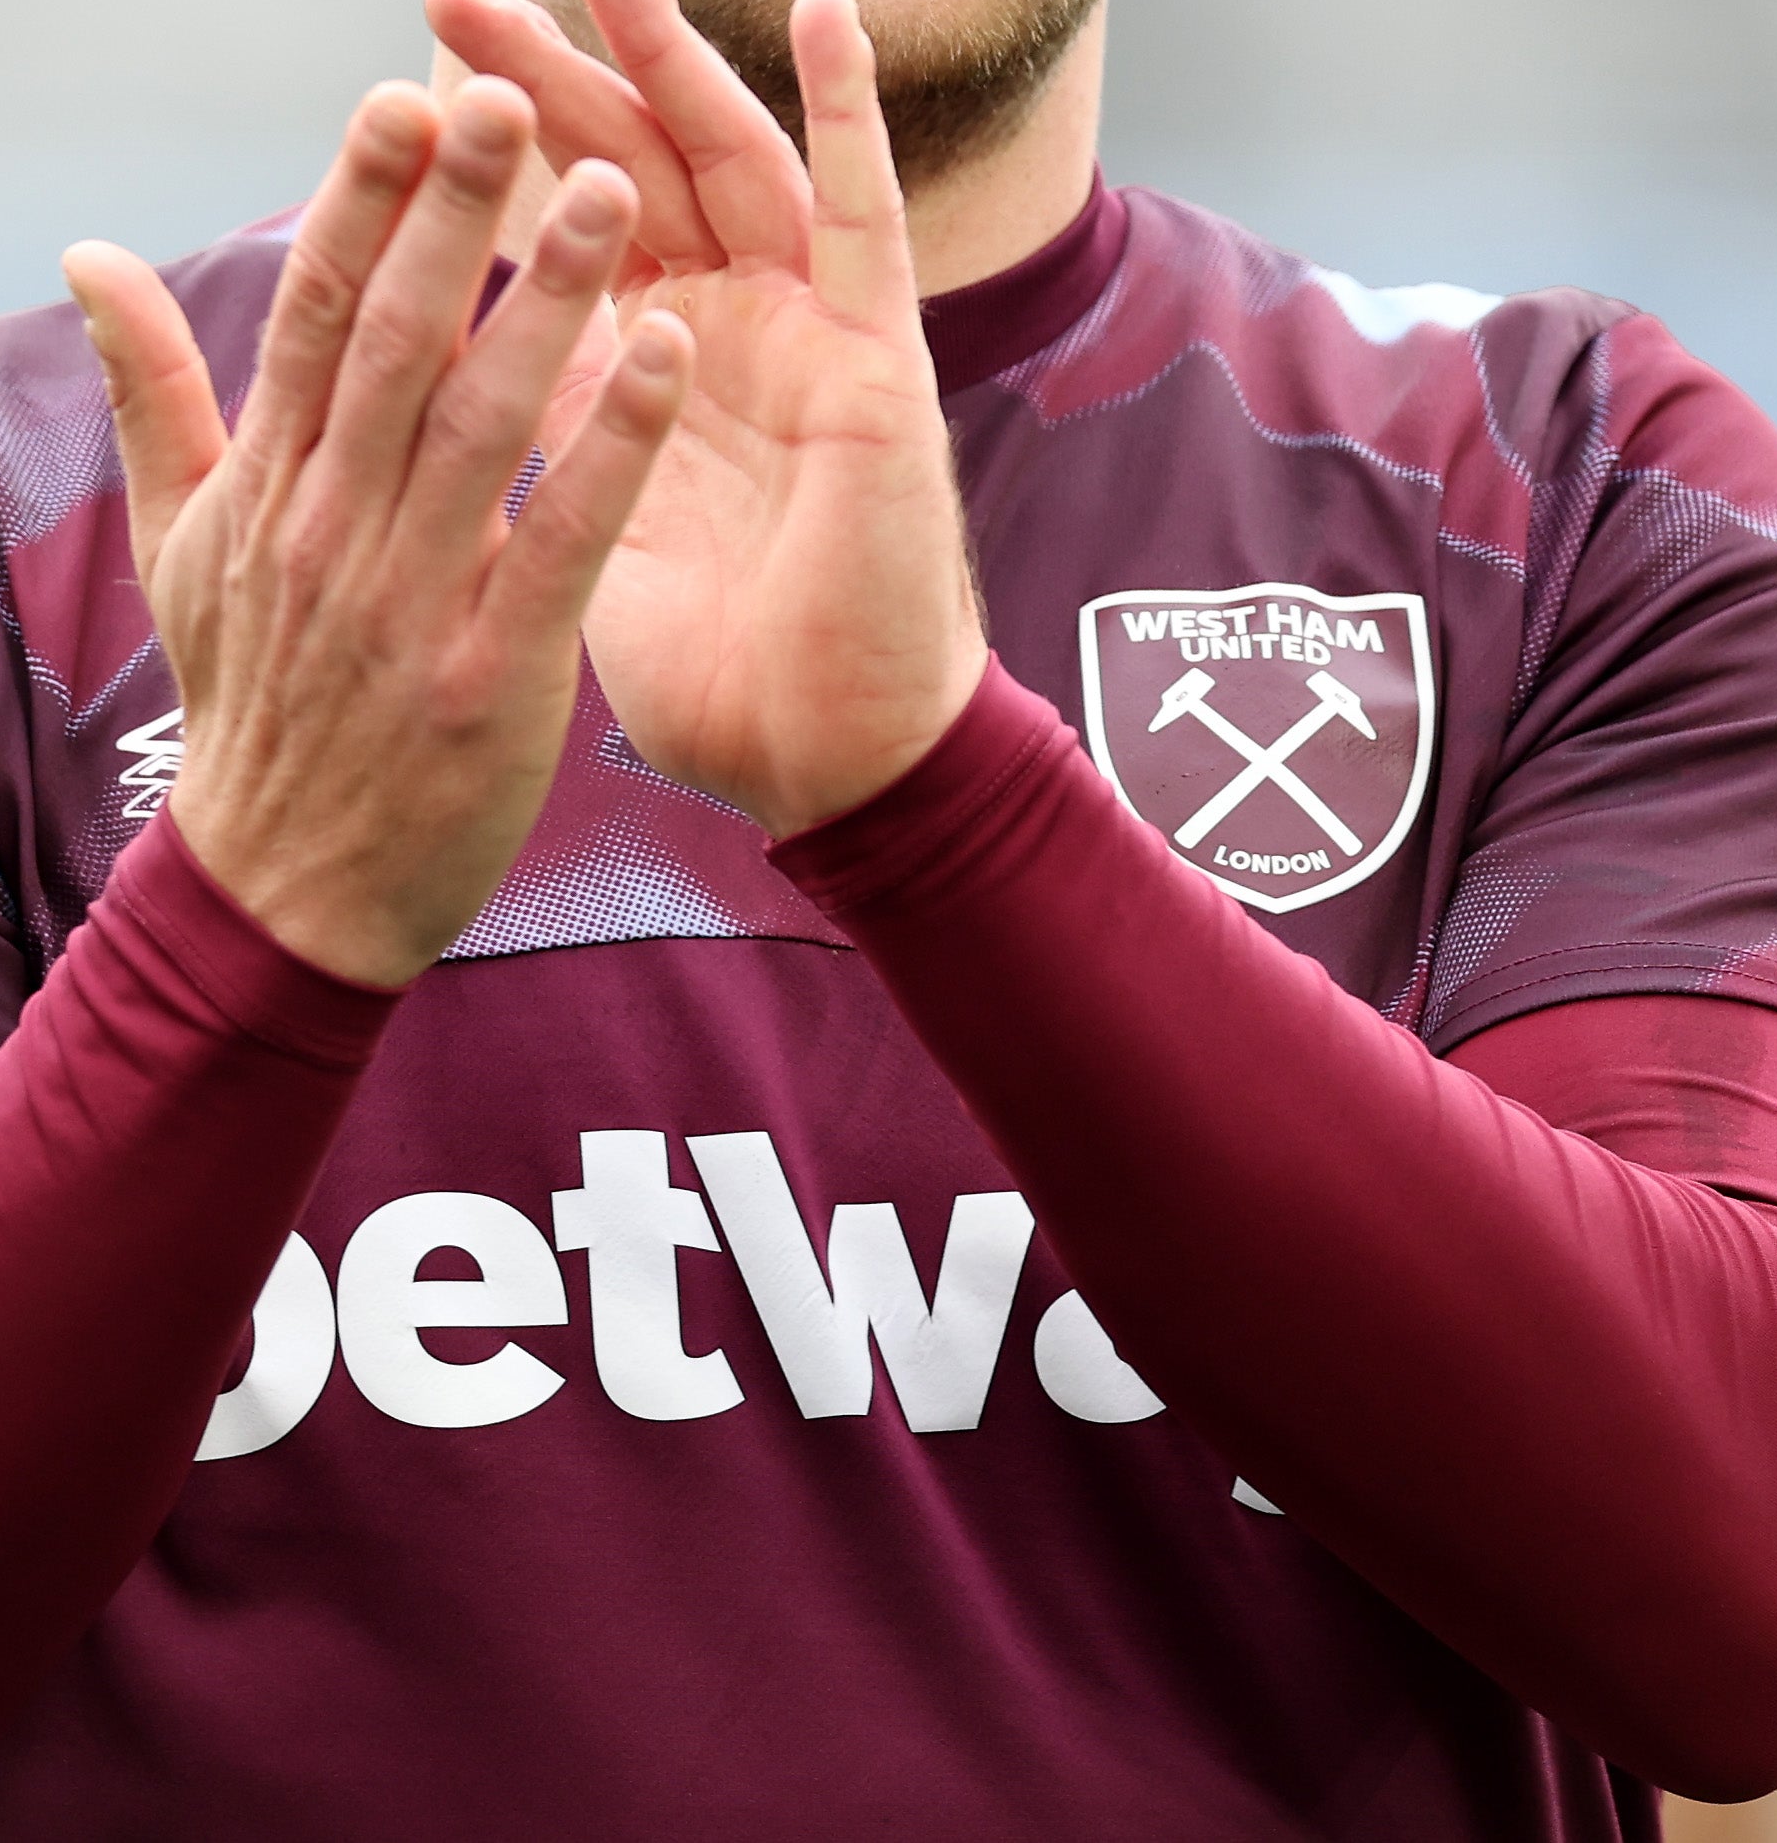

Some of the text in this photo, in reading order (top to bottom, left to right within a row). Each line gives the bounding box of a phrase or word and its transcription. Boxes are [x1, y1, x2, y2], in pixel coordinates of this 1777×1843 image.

[1121, 602, 1385, 654] WEST HAM
[1180, 632, 1332, 666] UNITED
[1213, 844, 1332, 875] LONDON
[193, 1130, 1286, 1515] etw
